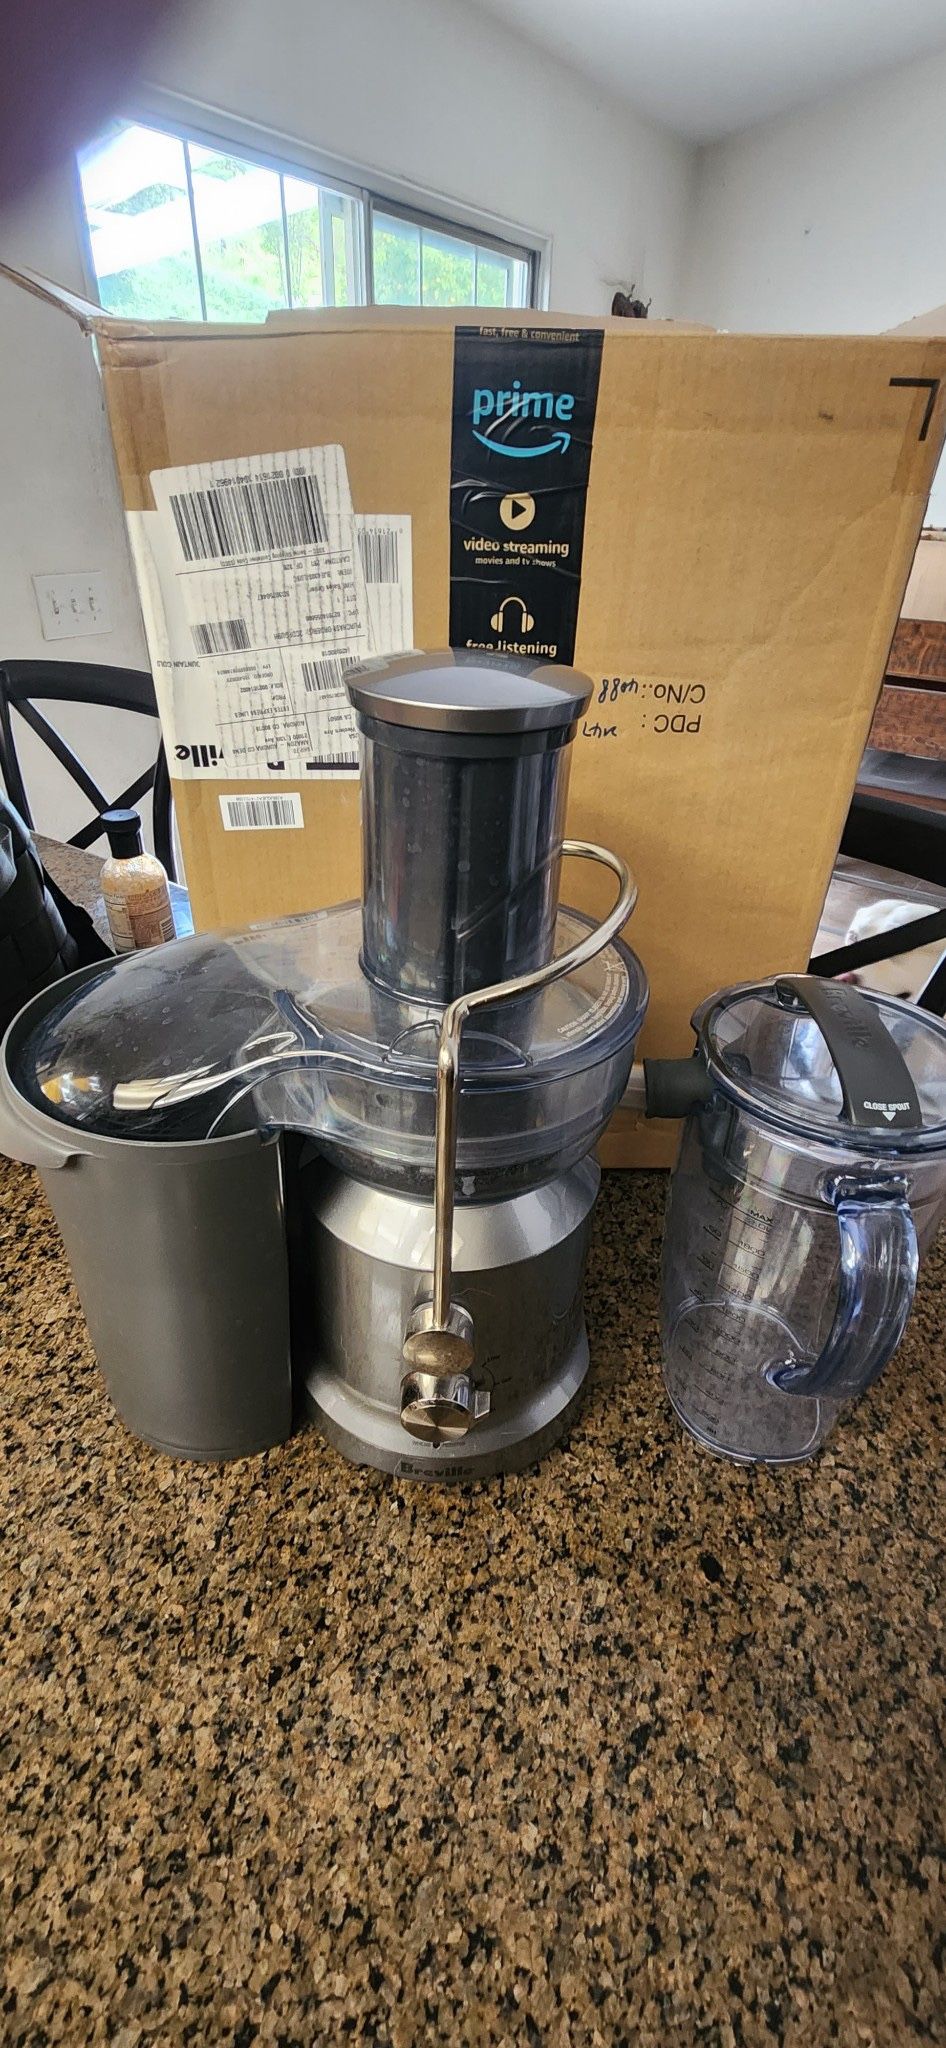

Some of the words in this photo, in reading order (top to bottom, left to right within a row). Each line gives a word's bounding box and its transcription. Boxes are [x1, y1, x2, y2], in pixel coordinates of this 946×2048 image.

[501, 327, 519, 336] free
[522, 328, 528, 338] &
[531, 329, 580, 342] convenient
[473, 380, 575, 425] prime
[463, 537, 500, 551] video
[503, 540, 570, 557] streaming
[475, 556, 504, 565] movies
[505, 556, 520, 565] and
[522, 557, 530, 566] tv
[497, 641, 557, 657] listening
[234, 711, 249, 719] LINES
[250, 707, 273, 717] EXPRESS
[654, 715, 701, 733] PDC
[255, 743, 278, 751] AURORA
[287, 740, 309, 748] AMAZON
[863, 1101, 888, 1111] CLOSE
[888, 1102, 910, 1111] SPOUT
[750, 1210, 773, 1223] MAX
[400, 1461, 475, 1477] Breville
